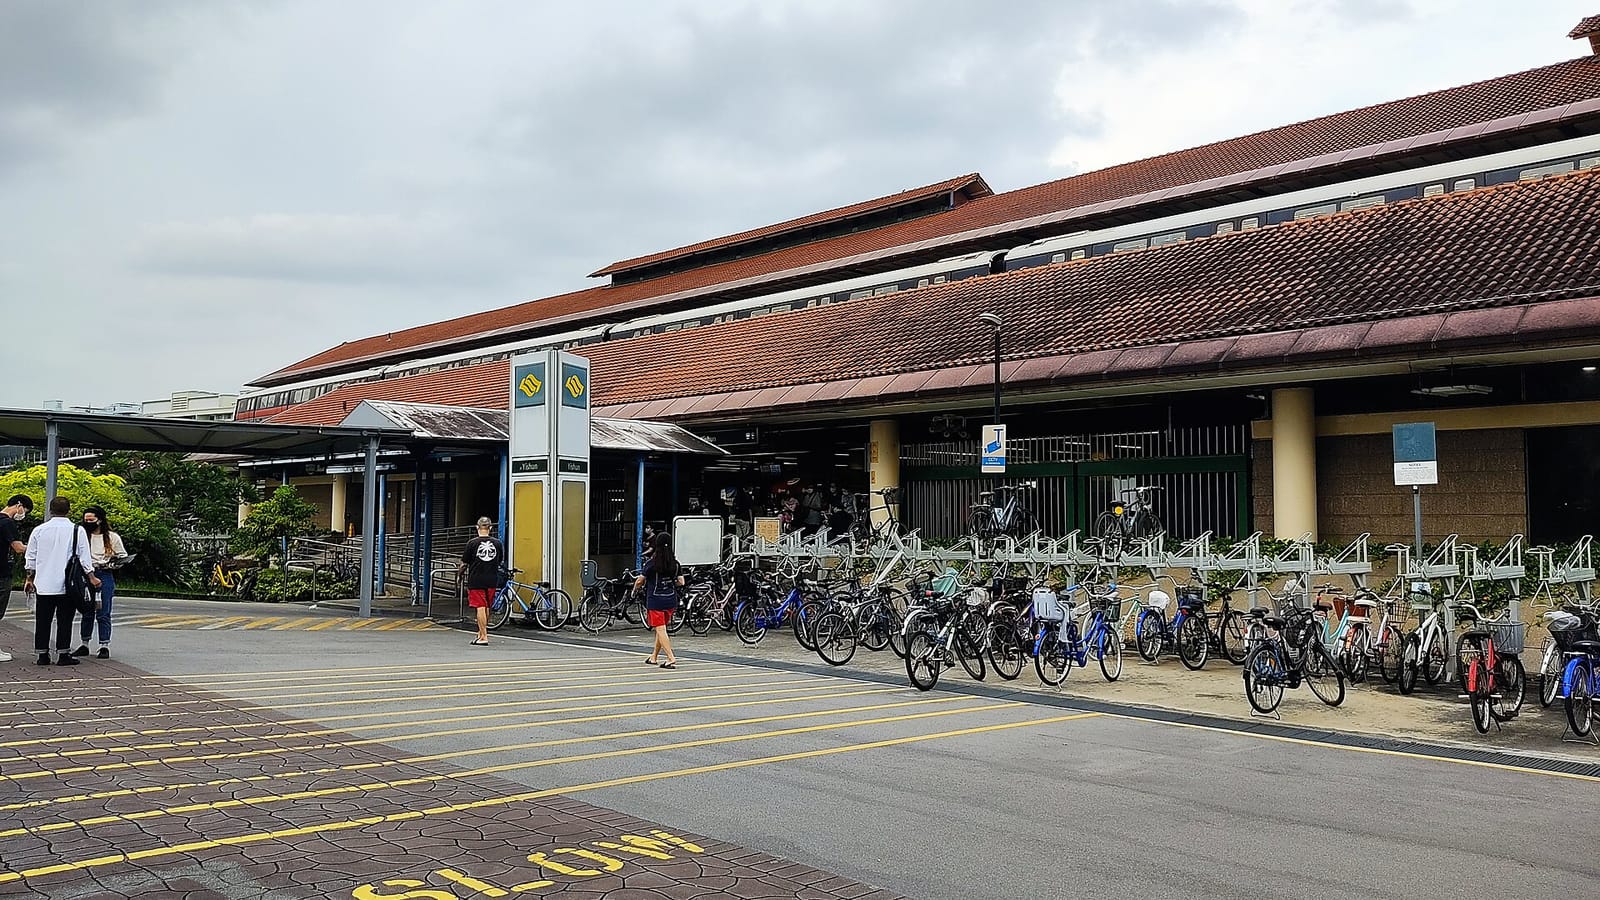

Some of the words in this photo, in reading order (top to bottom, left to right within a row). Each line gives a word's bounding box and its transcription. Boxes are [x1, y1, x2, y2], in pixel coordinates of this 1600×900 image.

[522, 461, 538, 470] Yishun
[567, 461, 581, 471] Yishun
[351, 829, 705, 900] SLOW
